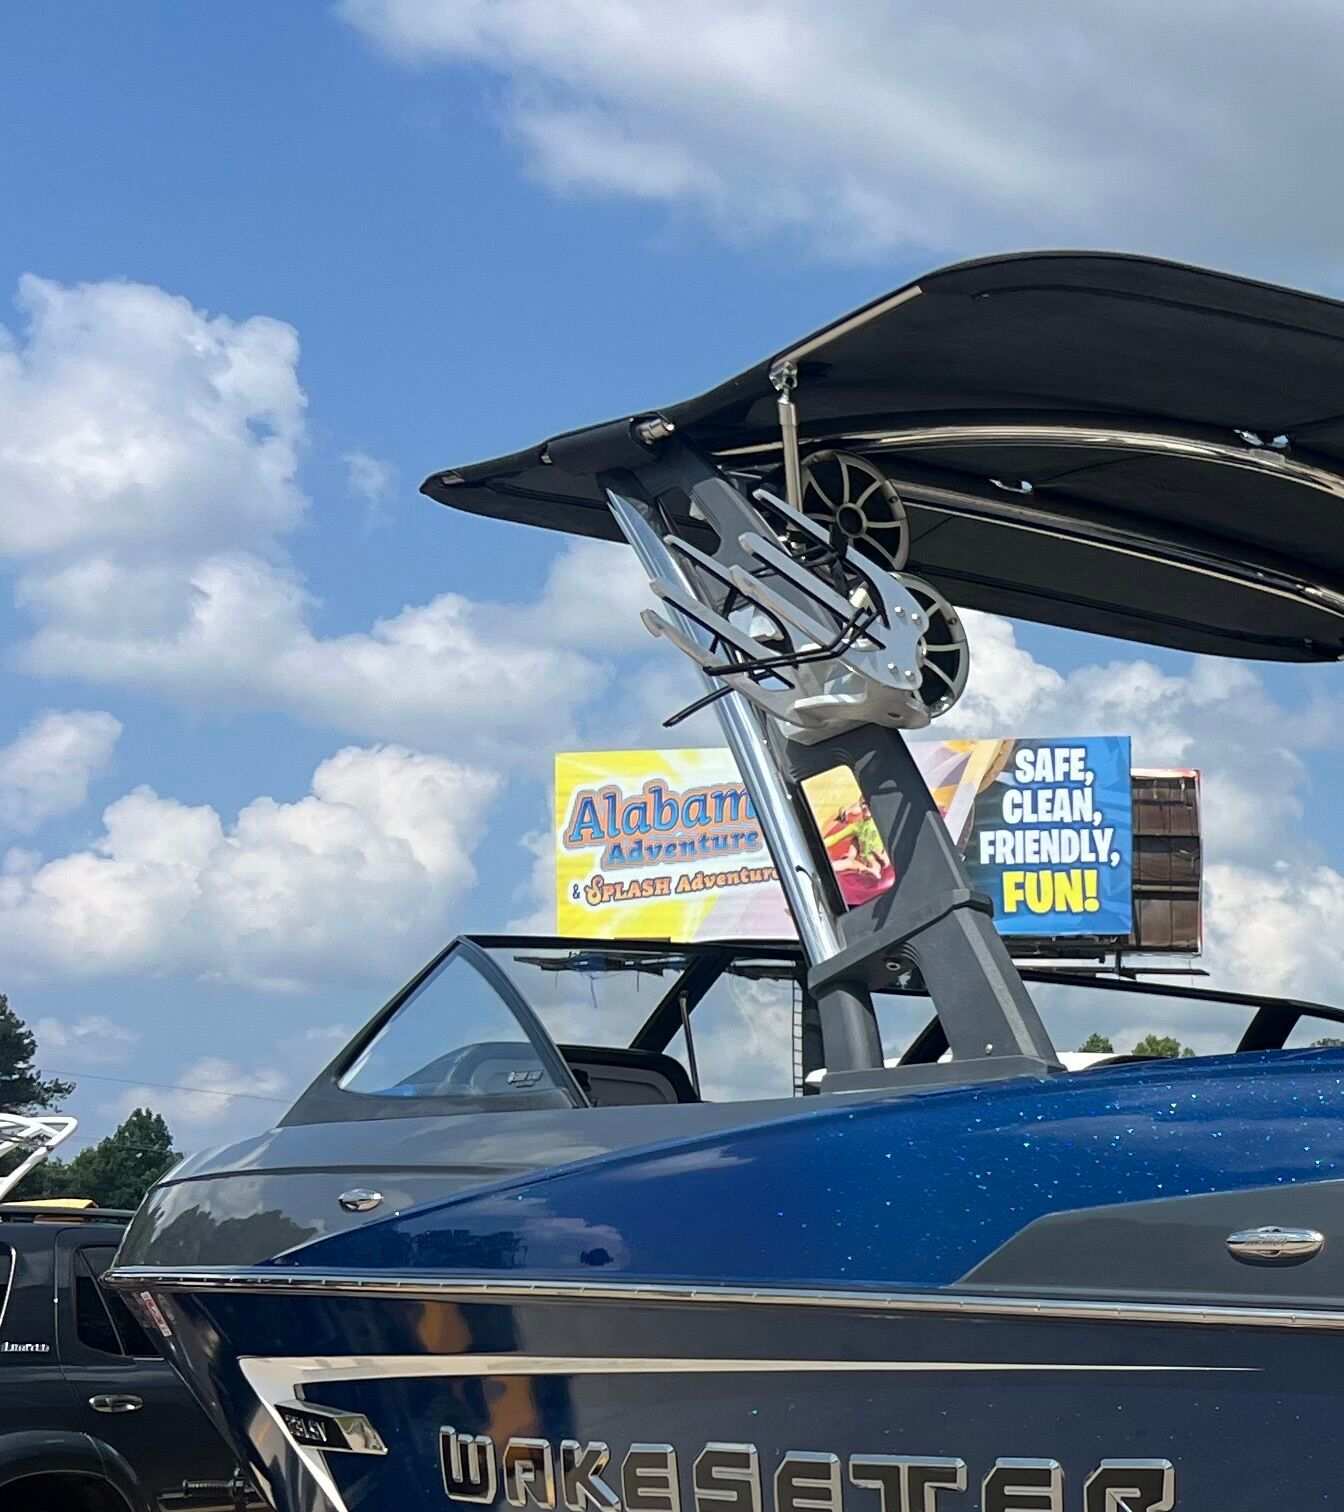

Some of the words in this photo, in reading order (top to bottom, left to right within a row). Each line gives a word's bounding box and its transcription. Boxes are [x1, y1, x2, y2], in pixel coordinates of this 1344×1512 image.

[1014, 747, 1095, 787] SAFE,
[568, 785, 758, 842] Alabam
[1002, 787, 1103, 827] CLEAN,
[607, 830, 760, 864] Adventure
[979, 827, 1121, 868] FRIENDLY,
[572, 883, 581, 899] &
[584, 874, 672, 907] SPLASH
[1002, 868, 1100, 914] FUN!
